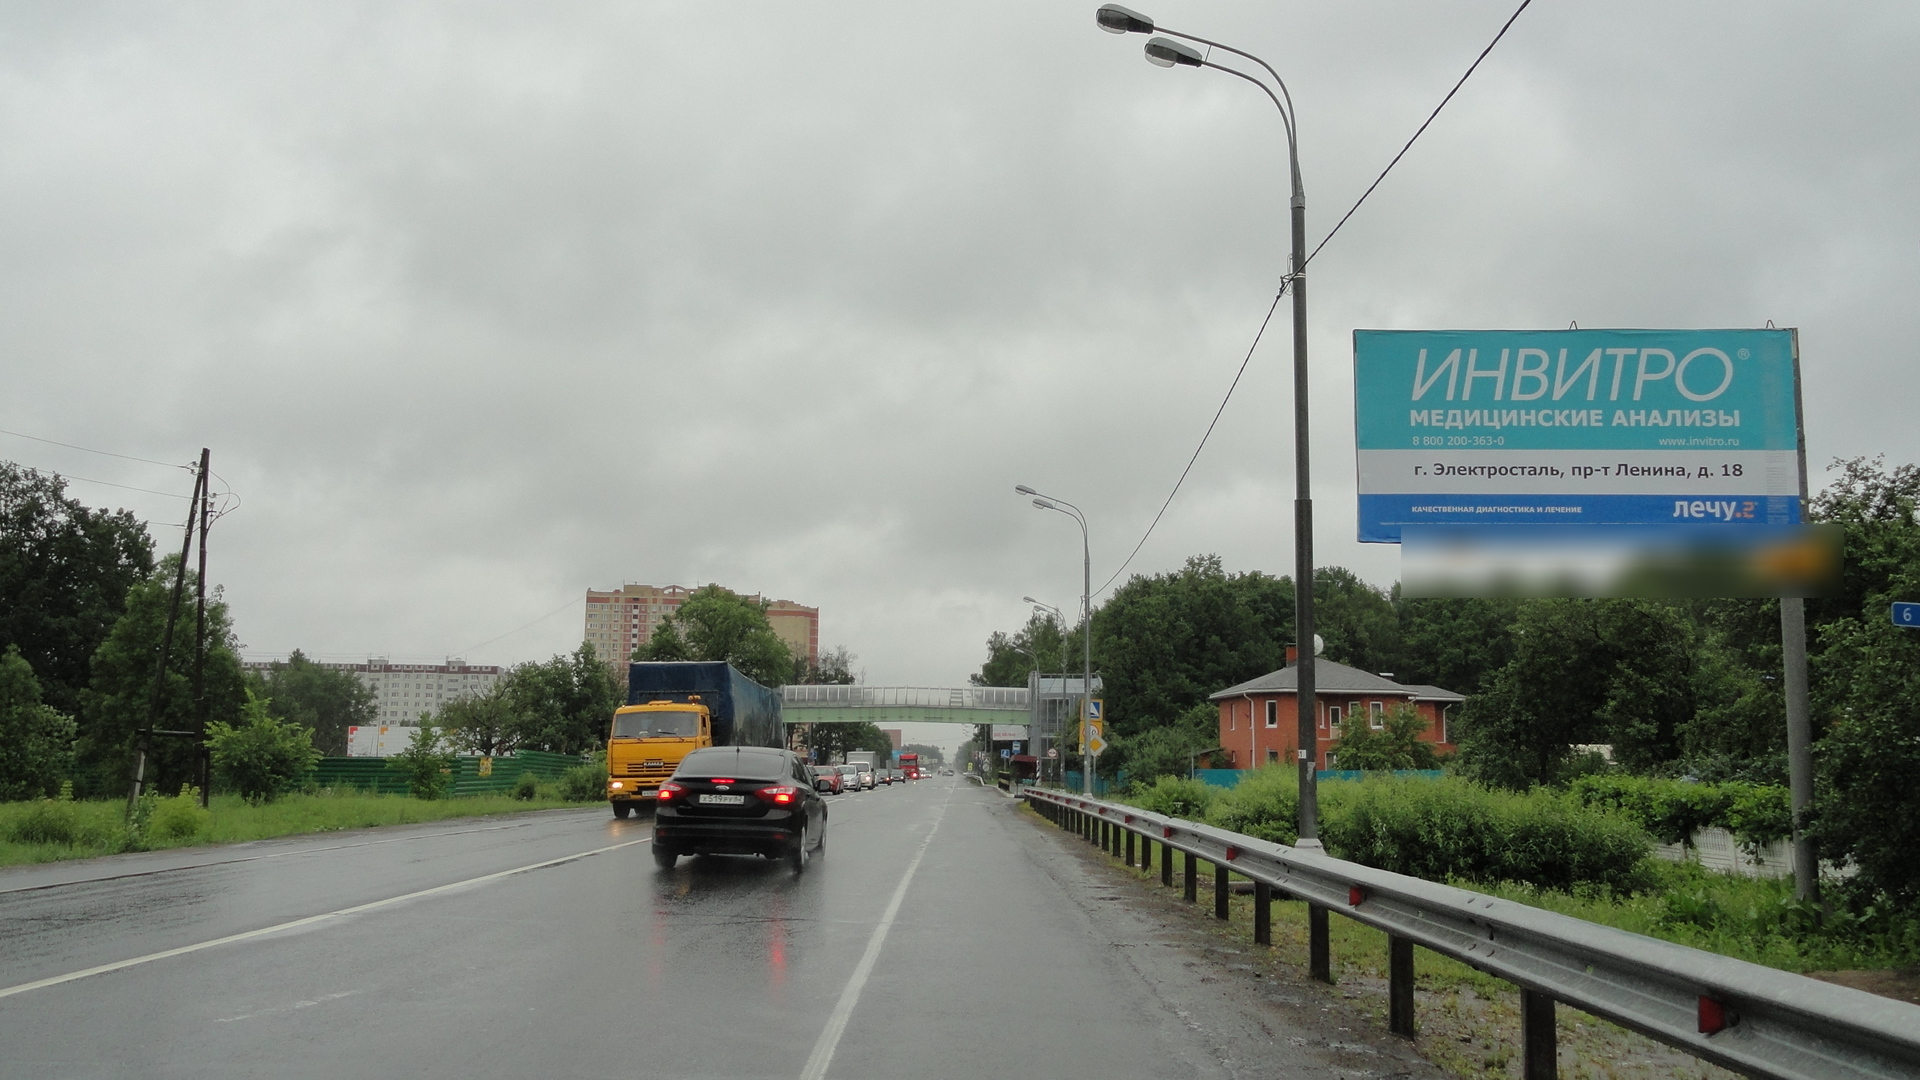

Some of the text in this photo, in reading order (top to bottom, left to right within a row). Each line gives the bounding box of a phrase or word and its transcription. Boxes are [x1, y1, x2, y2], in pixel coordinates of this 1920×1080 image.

[1411, 347, 1734, 402] ИНВИТРО
[1410, 409, 1741, 430] МЕДИЦИНСКИЕ АНАЛИЗЫ
[1412, 436, 1505, 446] 8 800 200-363-0
[1659, 436, 1740, 447] www.invitro.ru
[1414, 463, 1744, 479] г. Электросталь, пр-т Ленина, д. 18
[1475, 506, 1535, 514] ДИАГНОСТИКА
[1903, 608, 1912, 621] 6
